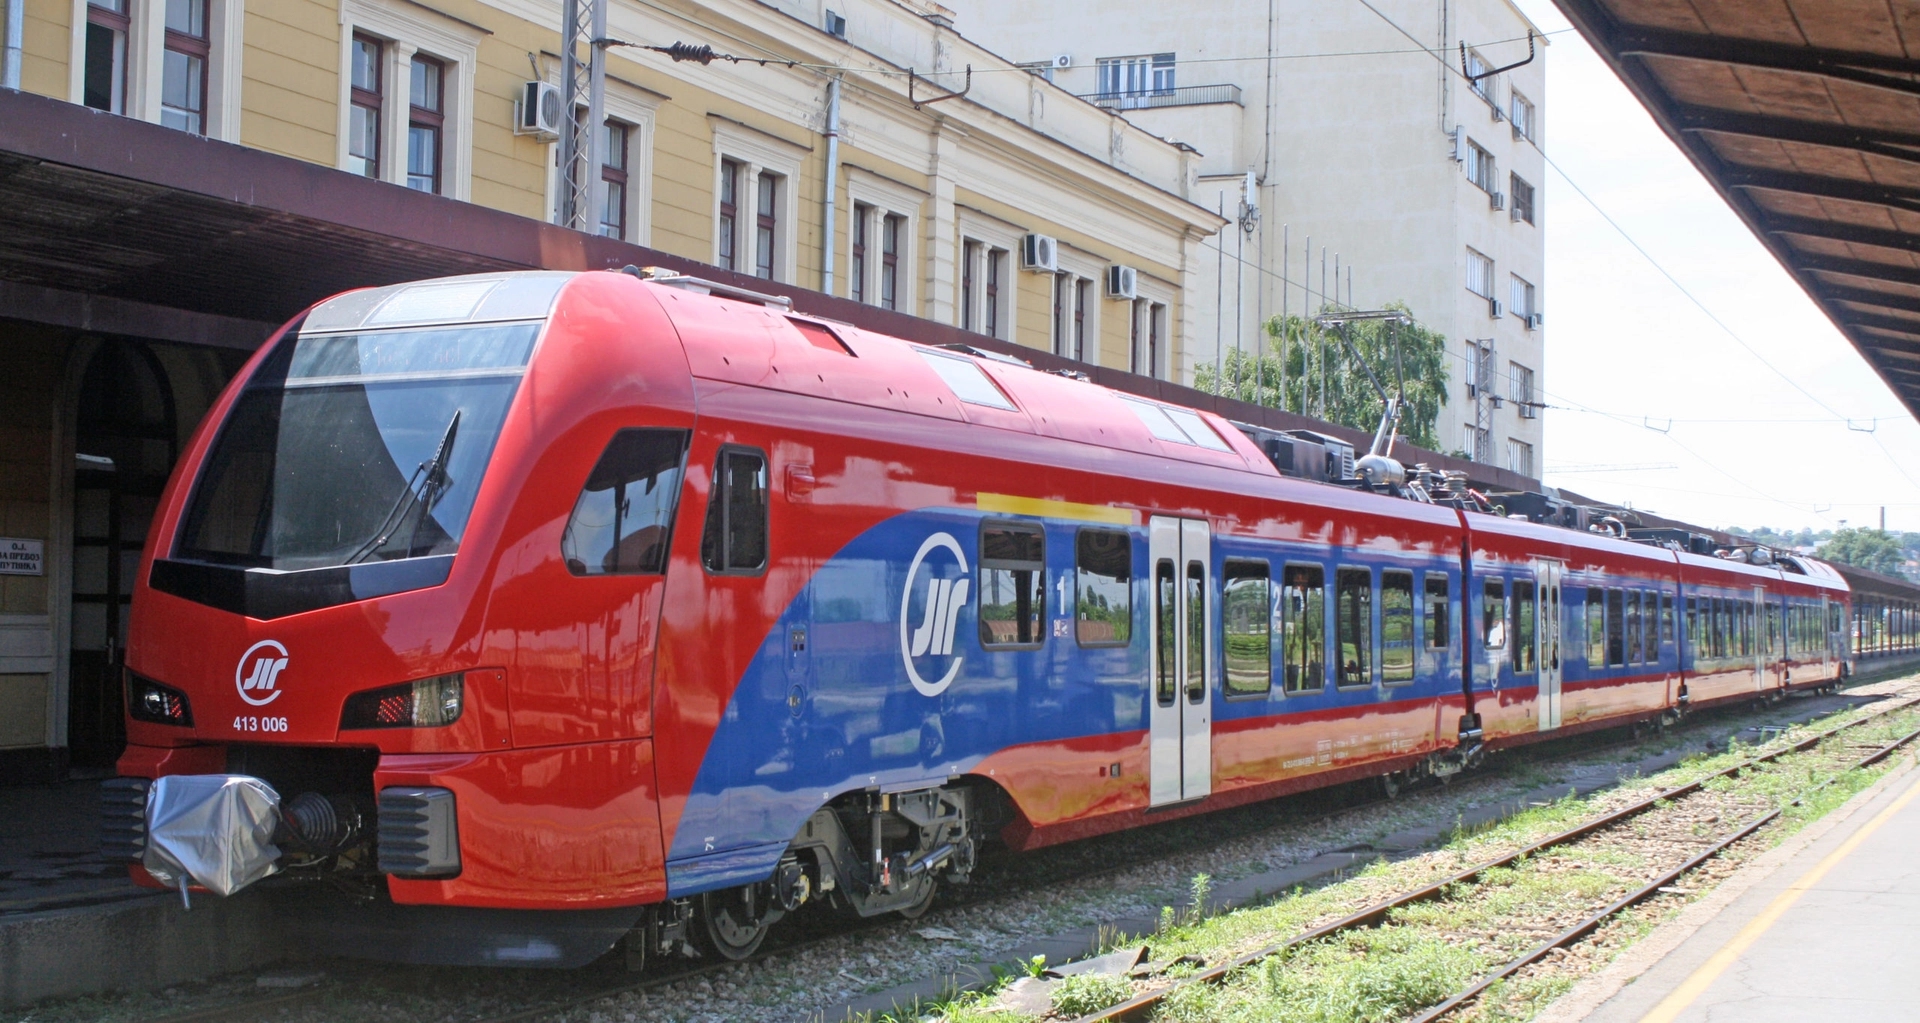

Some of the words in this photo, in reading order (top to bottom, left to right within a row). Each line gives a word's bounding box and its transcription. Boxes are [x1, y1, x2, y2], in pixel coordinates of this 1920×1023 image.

[1272, 585, 1281, 617] 2
[233, 715, 258, 732] 413
[261, 716, 289, 733] 006
